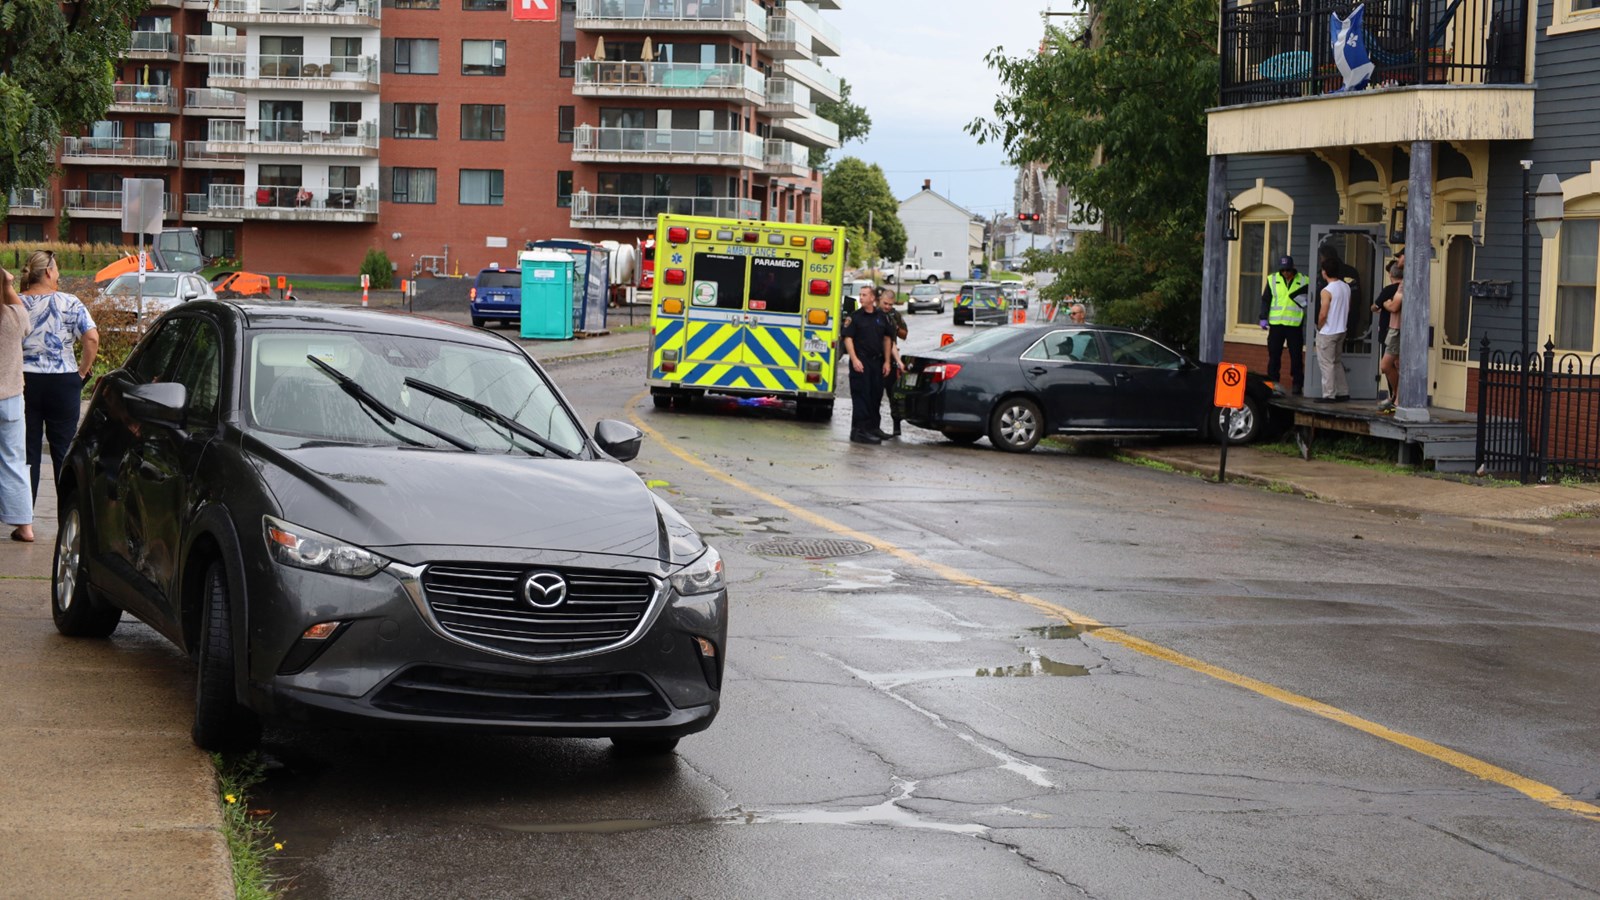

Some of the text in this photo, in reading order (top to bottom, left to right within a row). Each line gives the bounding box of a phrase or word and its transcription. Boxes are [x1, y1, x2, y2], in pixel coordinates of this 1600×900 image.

[726, 245, 776, 257] AMBULANCE
[754, 258, 800, 268] PARAMÉDIC
[810, 263, 835, 274] 6657
